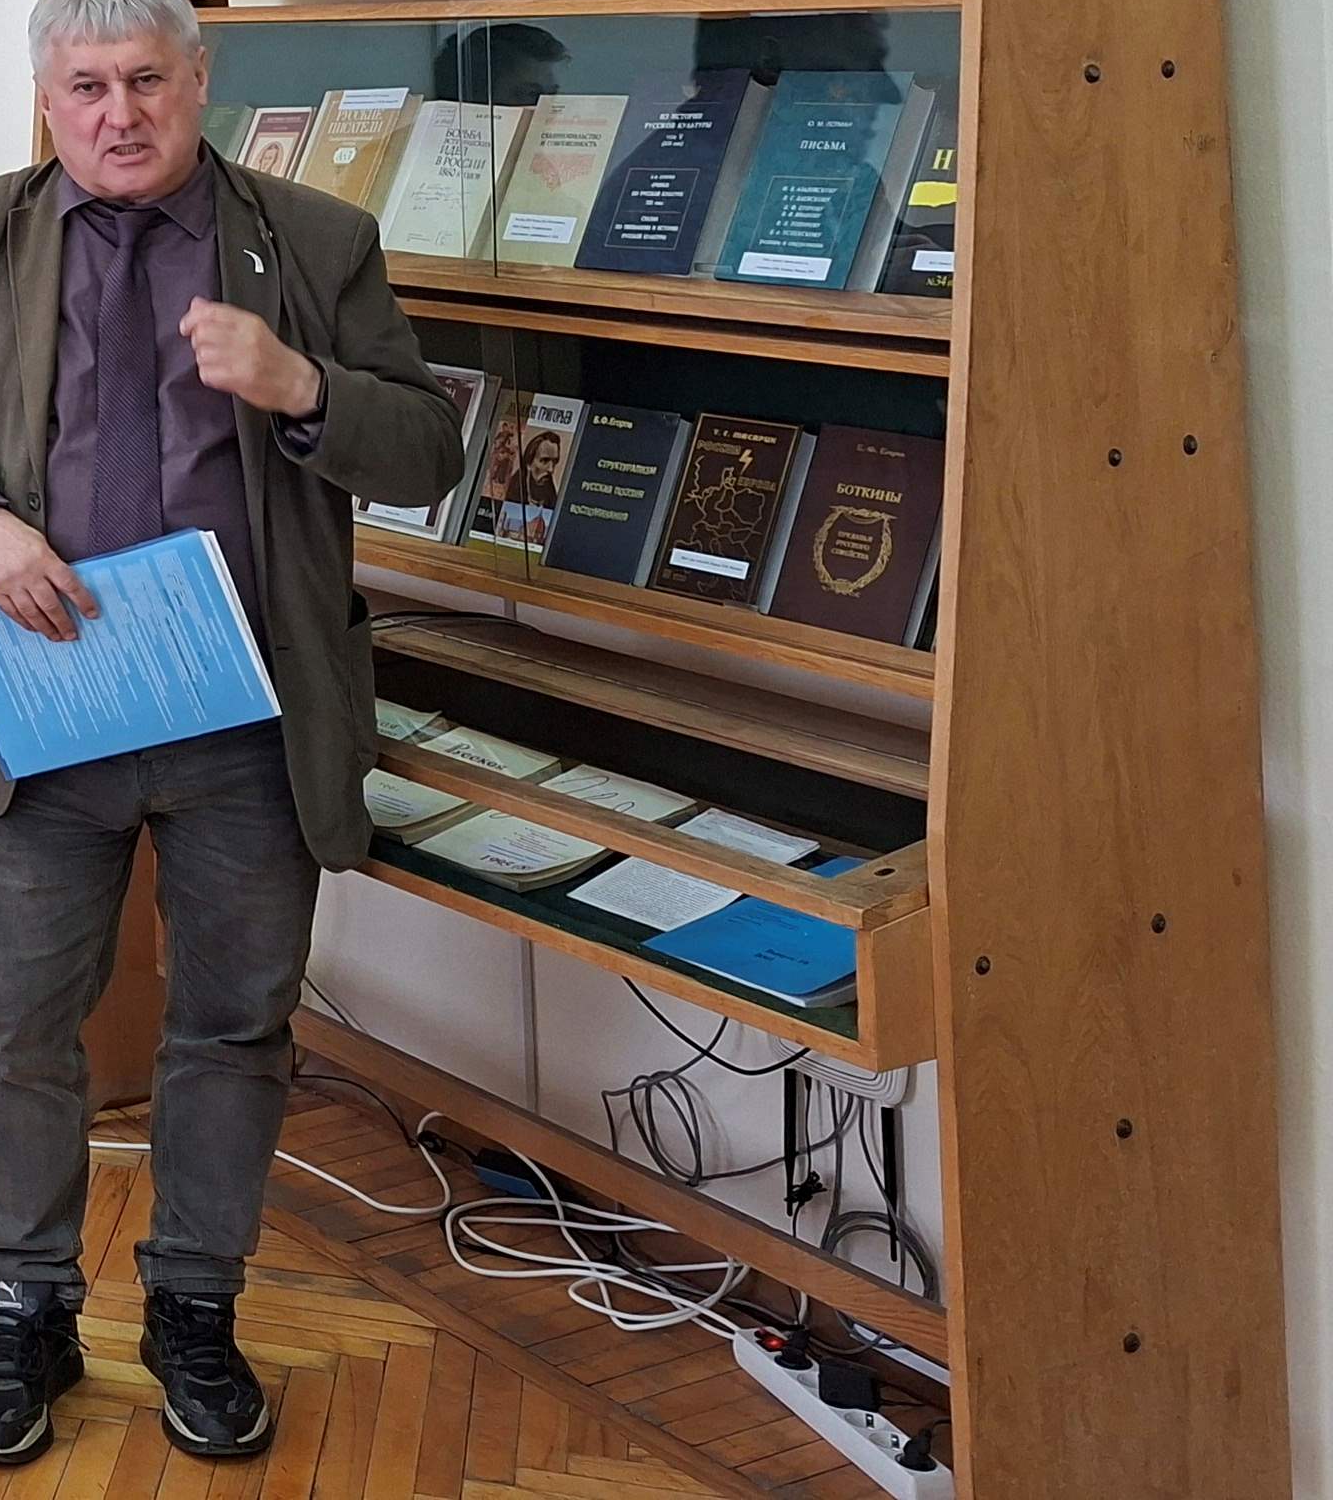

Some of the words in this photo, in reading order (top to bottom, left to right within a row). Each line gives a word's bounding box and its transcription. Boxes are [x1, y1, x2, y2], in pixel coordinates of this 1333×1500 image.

[327, 121, 383, 134] ПИСАТЕЛИ
[799, 139, 846, 151] ПИСЬМА
[435, 156, 443, 165] В
[443, 156, 486, 169] РОССИИ
[836, 482, 903, 504] БОТКИНЫ
